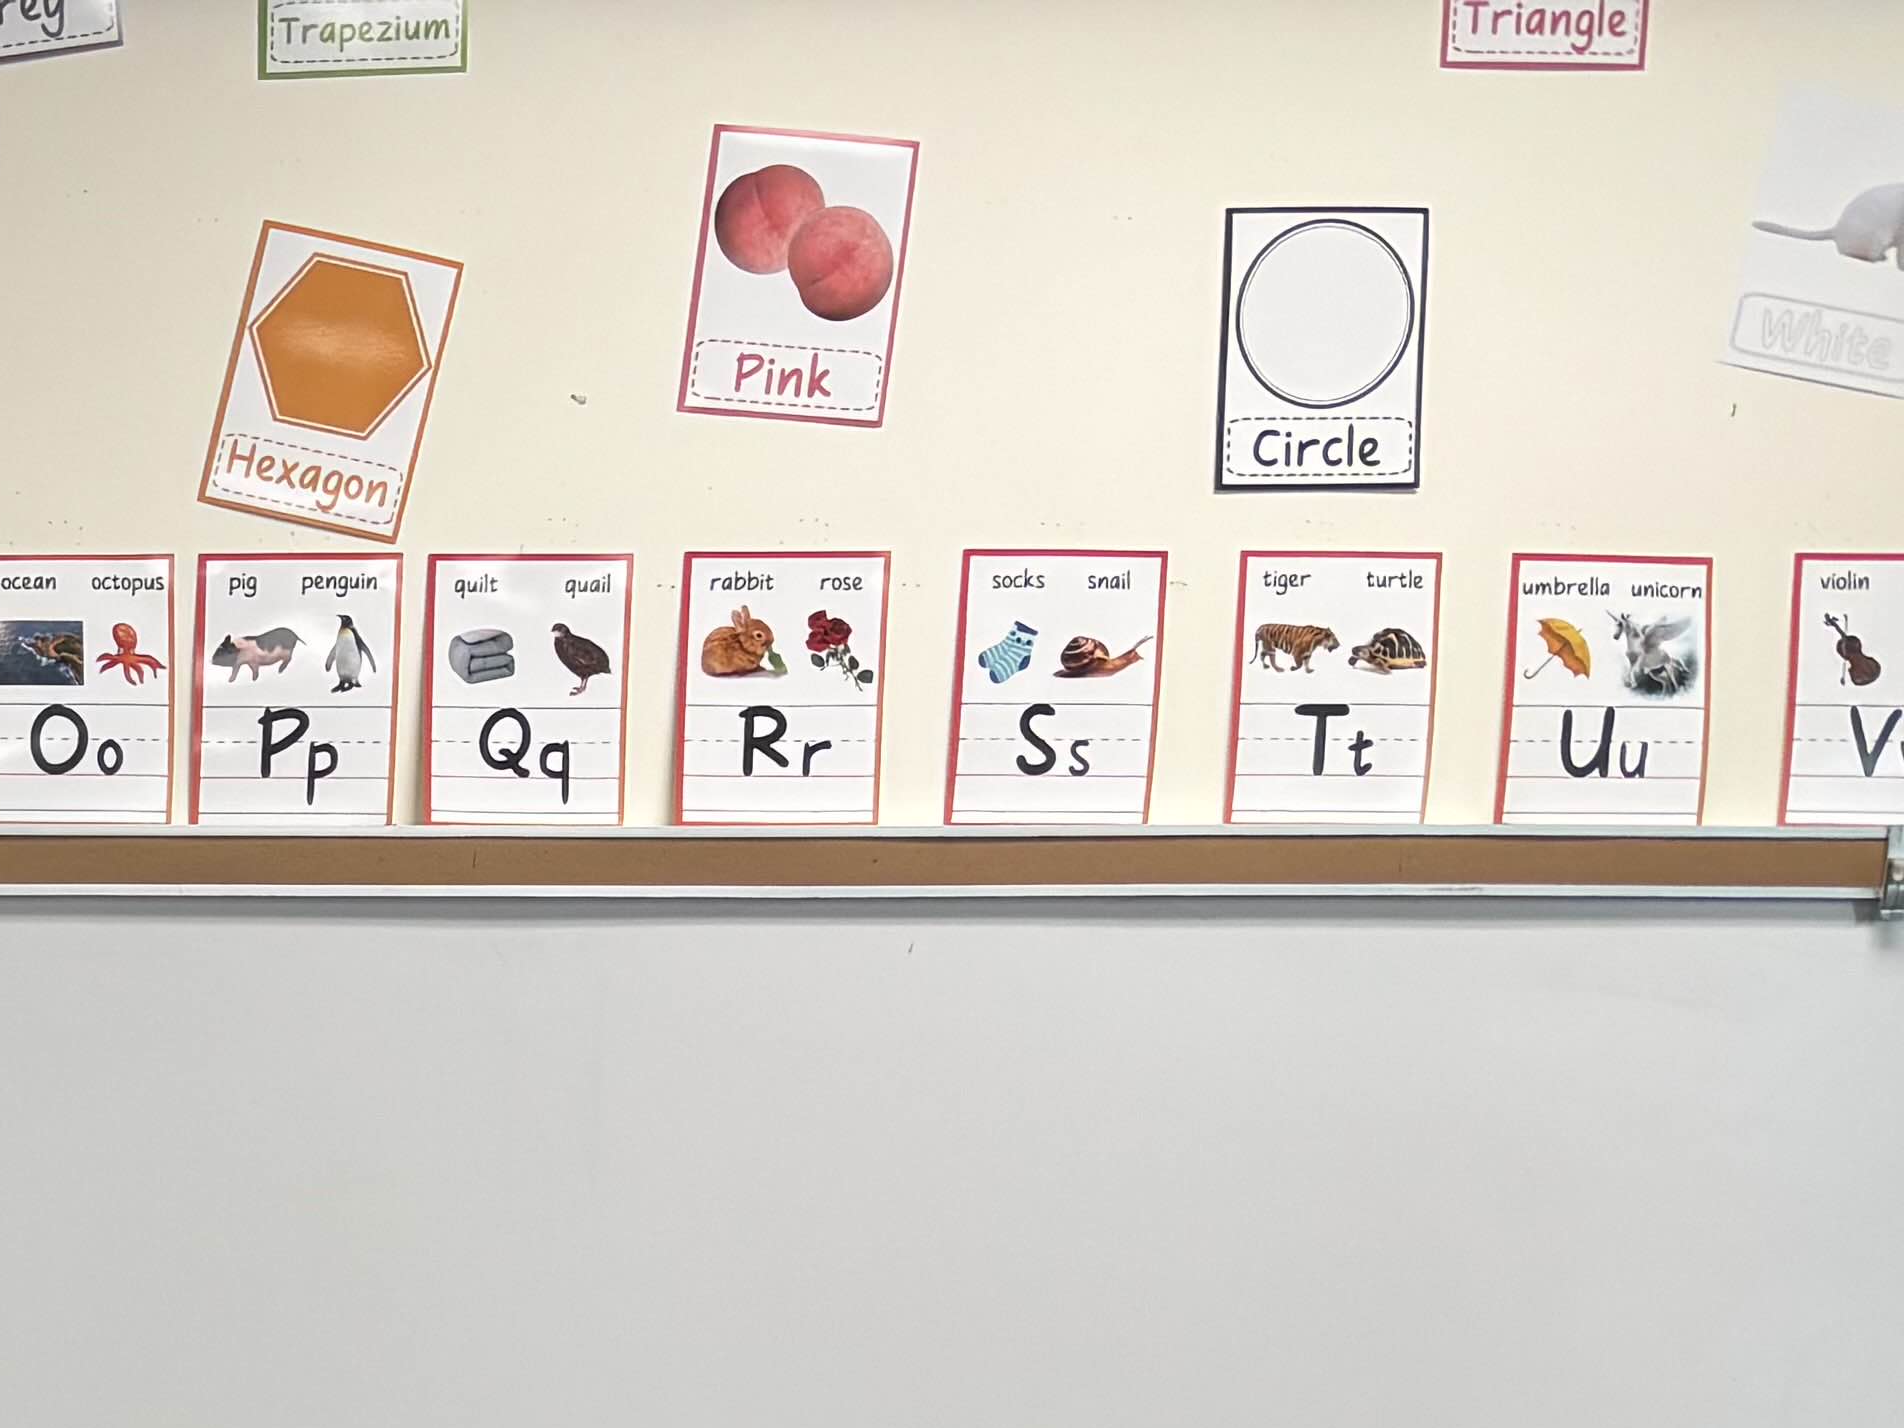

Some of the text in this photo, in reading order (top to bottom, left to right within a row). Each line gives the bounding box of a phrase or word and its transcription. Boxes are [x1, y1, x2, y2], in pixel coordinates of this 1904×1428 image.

[278, 16, 450, 53] Trapezium
[1463, 0, 1627, 54] Triangle
[1762, 308, 1892, 370] White
[735, 352, 831, 398] Pink
[1253, 423, 1380, 467] Circle
[222, 439, 387, 514] Hexagon
[1, 575, 164, 596] ocean octopus
[229, 573, 377, 597] pig penguin
[455, 573, 611, 599] quilt quail
[710, 571, 863, 591] rabbit rose
[992, 568, 1130, 590] socks snail
[1263, 569, 1423, 595] tiger turtle
[1523, 576, 1702, 598] umbrella unicorn
[1821, 570, 1869, 590] violin
[1851, 708, 1904, 776] V
